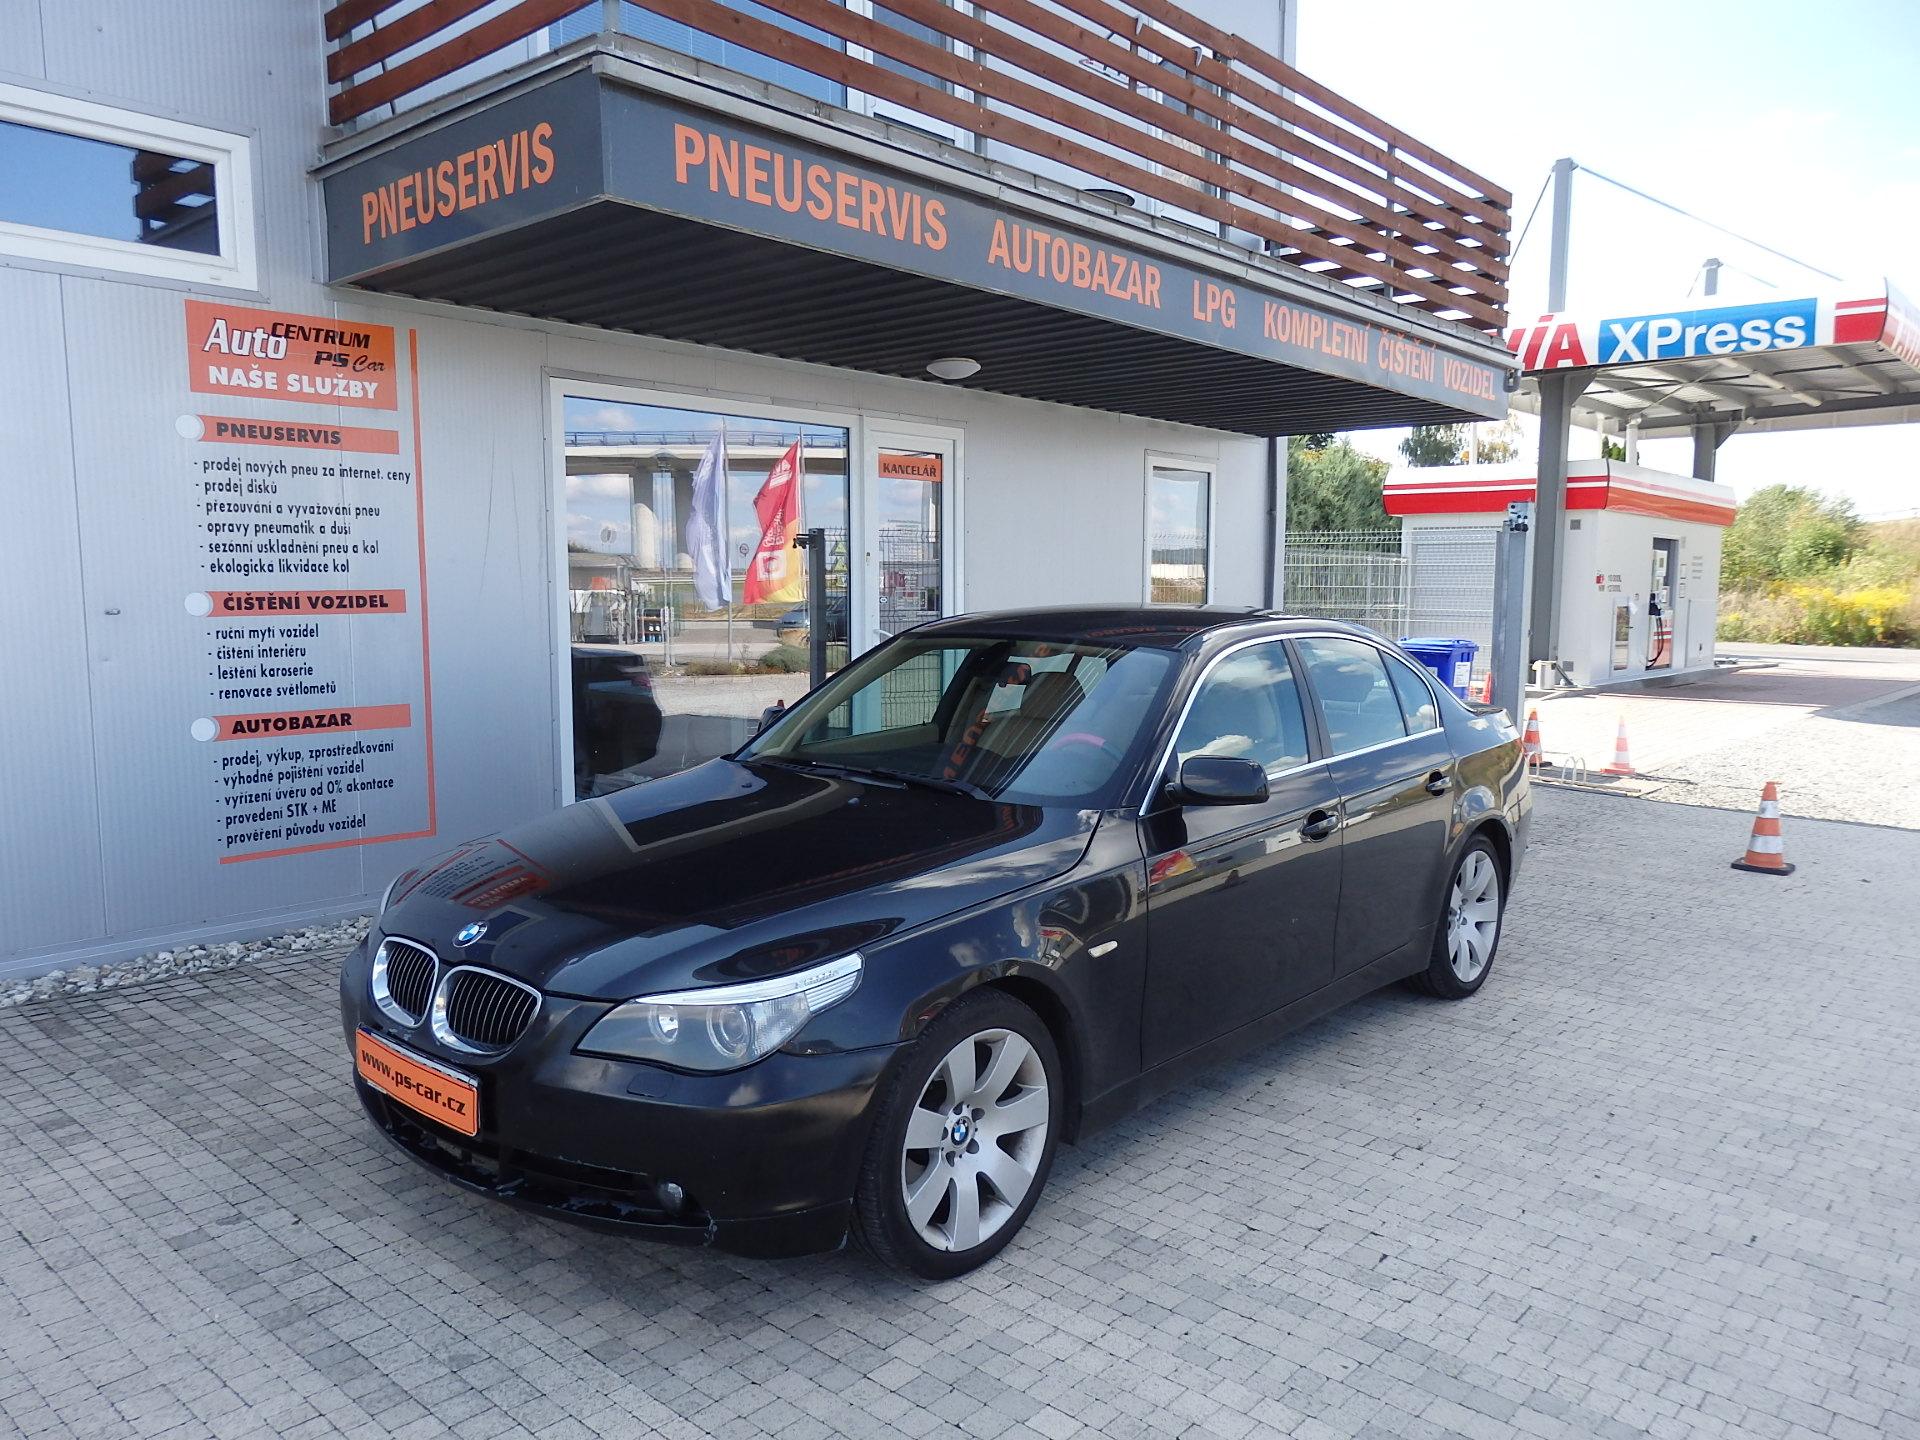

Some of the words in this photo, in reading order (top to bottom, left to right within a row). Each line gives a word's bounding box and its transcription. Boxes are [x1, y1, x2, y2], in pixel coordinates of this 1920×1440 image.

[362, 121, 555, 244] PNEUSERVIS
[675, 122, 948, 252] PNEUSERVIS
[988, 218, 1162, 309] AUTOBAZAR
[1193, 278, 1236, 330] LPG
[1264, 301, 1371, 364] KOMPLETNÍ
[1378, 329, 1435, 382] ČIŠTĚNÍ
[1443, 359, 1495, 401] VOZIDEL
[203, 317, 288, 360] Auto
[271, 322, 370, 348] CENTRUM
[1608, 314, 1806, 363] XPress
[314, 351, 350, 367] PS
[352, 355, 385, 372] Car
[209, 364, 277, 390] NAŠE
[287, 373, 378, 399] SLUŽBY
[217, 422, 341, 446] PNEUSERVIS
[203, 458, 242, 476] prodej
[246, 460, 286, 477] nových
[291, 466, 317, 479] pneu
[322, 467, 335, 476] za
[387, 470, 411, 484] ceny
[883, 462, 936, 477] KANCELÁŘ
[205, 479, 243, 496] prodej
[247, 479, 277, 494] disků
[206, 500, 271, 516] přezouvání
[288, 502, 351, 518] vyvažování
[355, 506, 380, 519] pneu
[207, 522, 249, 537] opravy
[255, 521, 314, 537] pneumatik
[209, 541, 253, 553] sezónní
[257, 540, 318, 554] uskladnění
[323, 543, 349, 556] pneu
[362, 540, 379, 554] kol
[210, 559, 274, 576] ekologická
[279, 559, 328, 573] likvidace
[333, 559, 349, 573] kol
[223, 592, 300, 611] ČIŠTĚNÍ
[307, 595, 388, 610] VOZIDEL
[216, 626, 245, 640] ruční
[280, 623, 319, 638] vozidel
[217, 645, 254, 660] čištění
[258, 643, 306, 658] interiéru
[218, 665, 256, 680] leštění
[261, 662, 313, 678] karoserie
[219, 686, 272, 699] renovace
[277, 680, 336, 697] světlometů
[232, 713, 352, 734] AUTOBAZAR
[222, 751, 262, 770] prodej,
[267, 748, 304, 765] výkup,
[309, 739, 394, 760] zprostředkování
[224, 771, 273, 789] výhodné
[278, 764, 323, 784] pojištění
[327, 759, 364, 775] vozidel
[276, 787, 306, 801] úvěru
[311, 782, 323, 797] od
[347, 777, 394, 793] akontace
[226, 810, 283, 829] provedení
[287, 802, 308, 818] STK
[322, 799, 337, 814] ME
[227, 829, 281, 848] prověření
[286, 822, 325, 840] původu
[329, 814, 366, 831] vozidel
[362, 1050, 465, 1116] www.ps-car.cz
